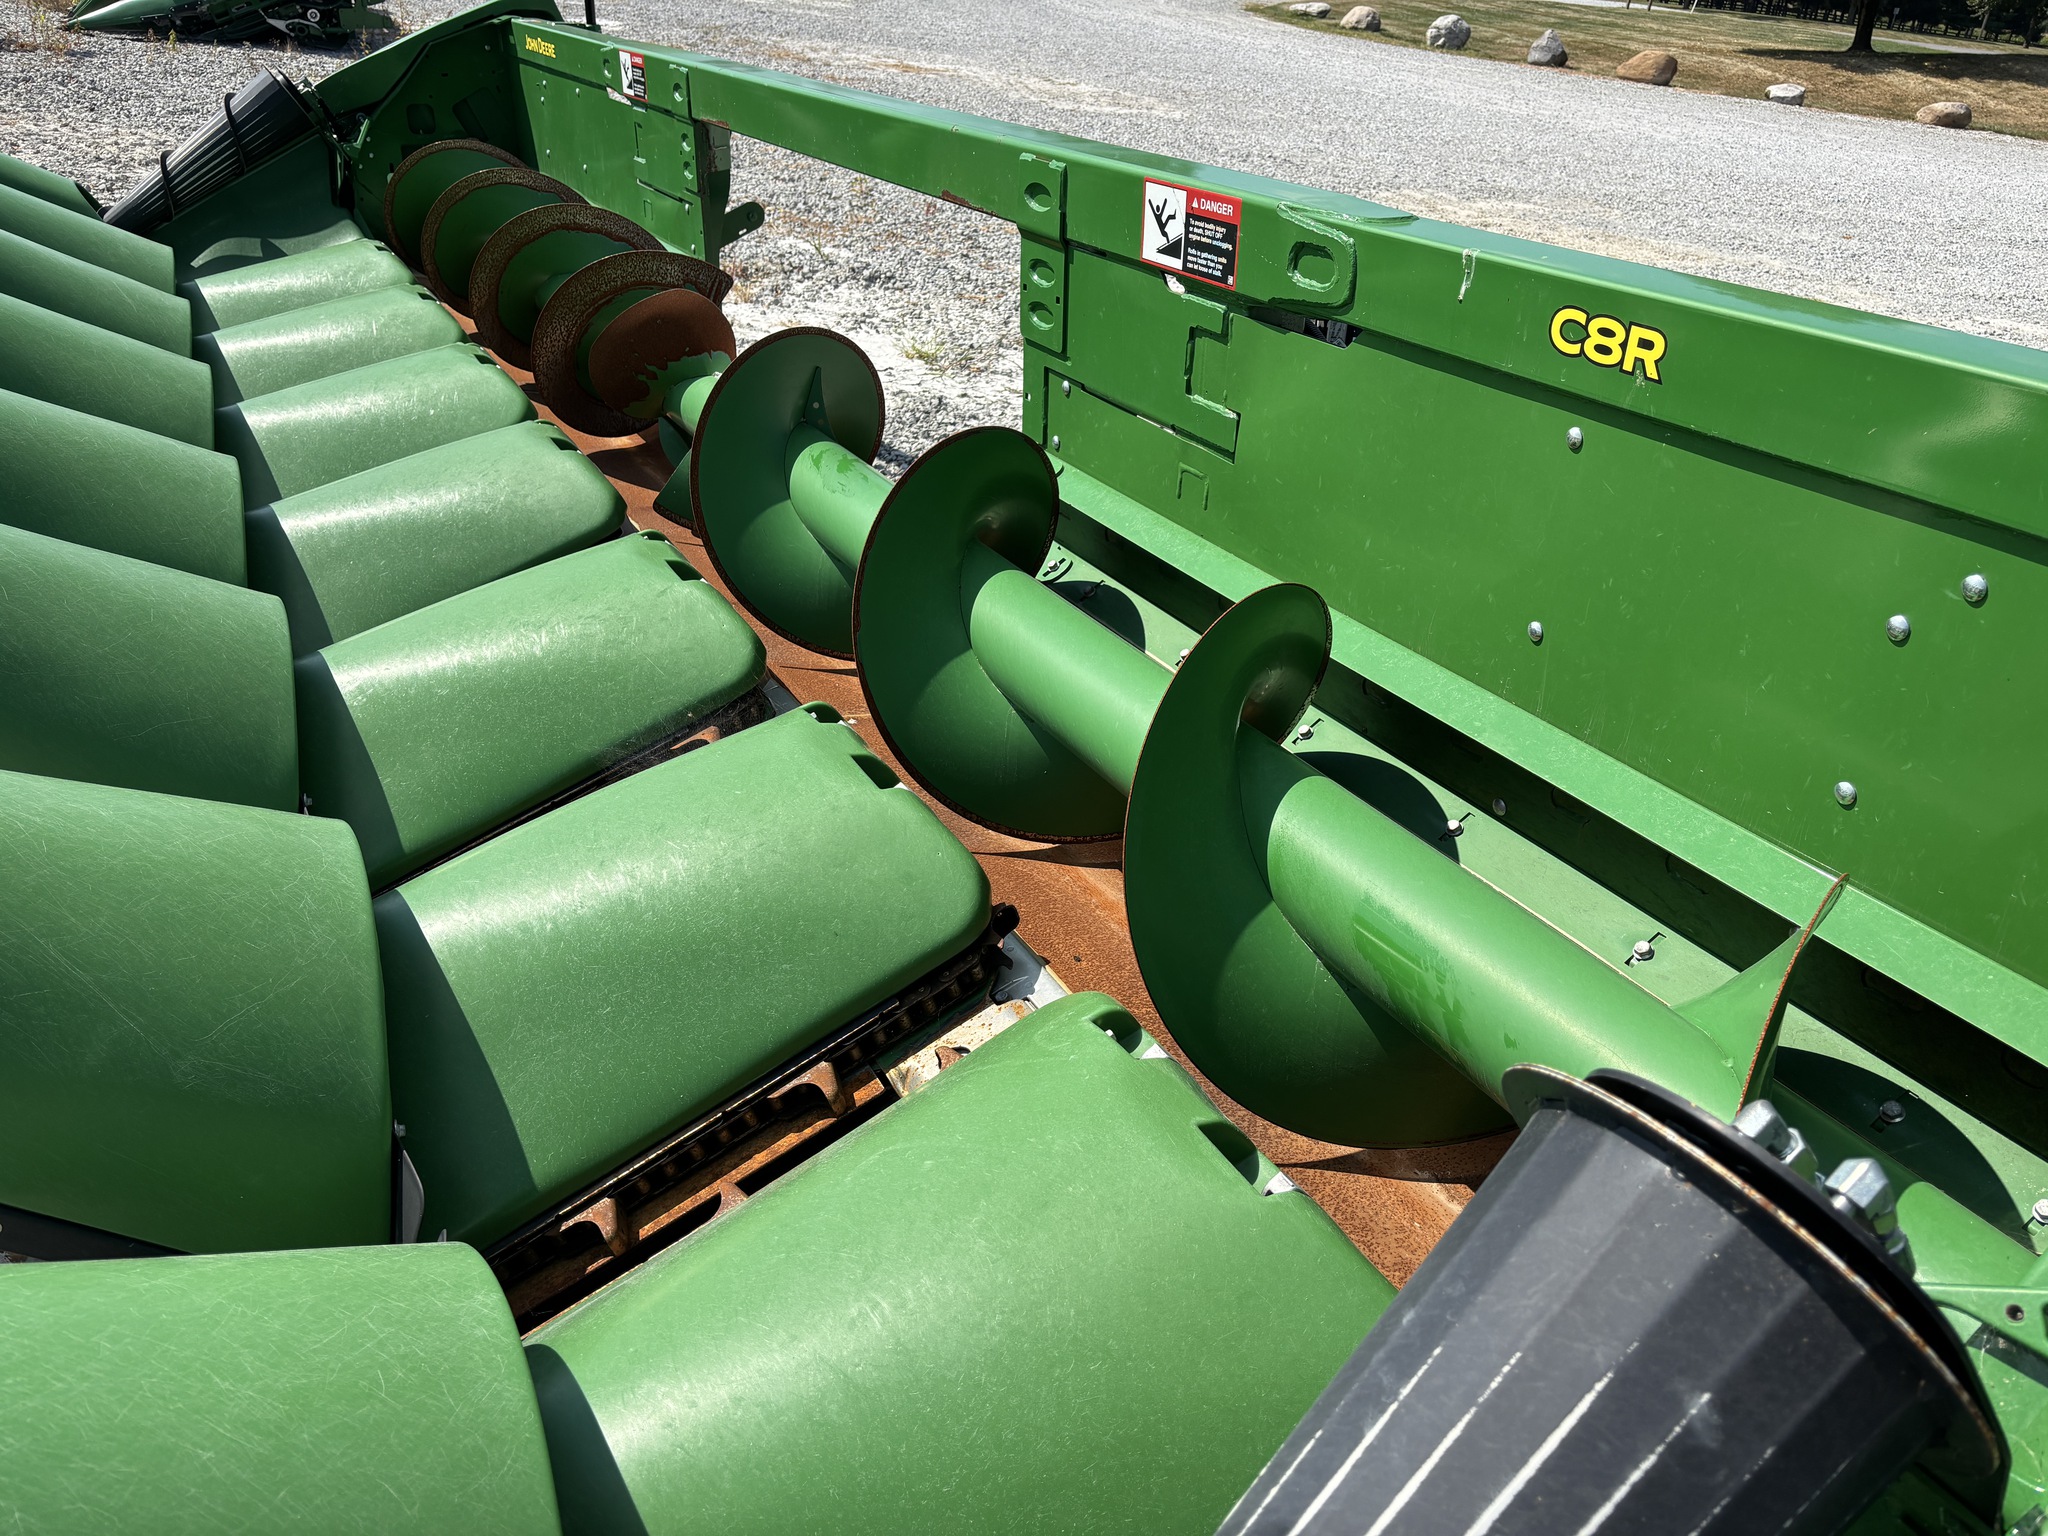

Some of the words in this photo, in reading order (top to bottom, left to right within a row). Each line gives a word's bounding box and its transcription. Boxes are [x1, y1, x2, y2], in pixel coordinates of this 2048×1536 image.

[526, 34, 539, 53] JOHN
[538, 37, 556, 58] DEERE
[1200, 198, 1234, 216] DANGER
[1201, 236, 1211, 244] before
[1197, 257, 1207, 265] faster
[1201, 252, 1217, 262] gathering
[1199, 264, 1208, 273] loose
[1549, 305, 1668, 385] C8R
